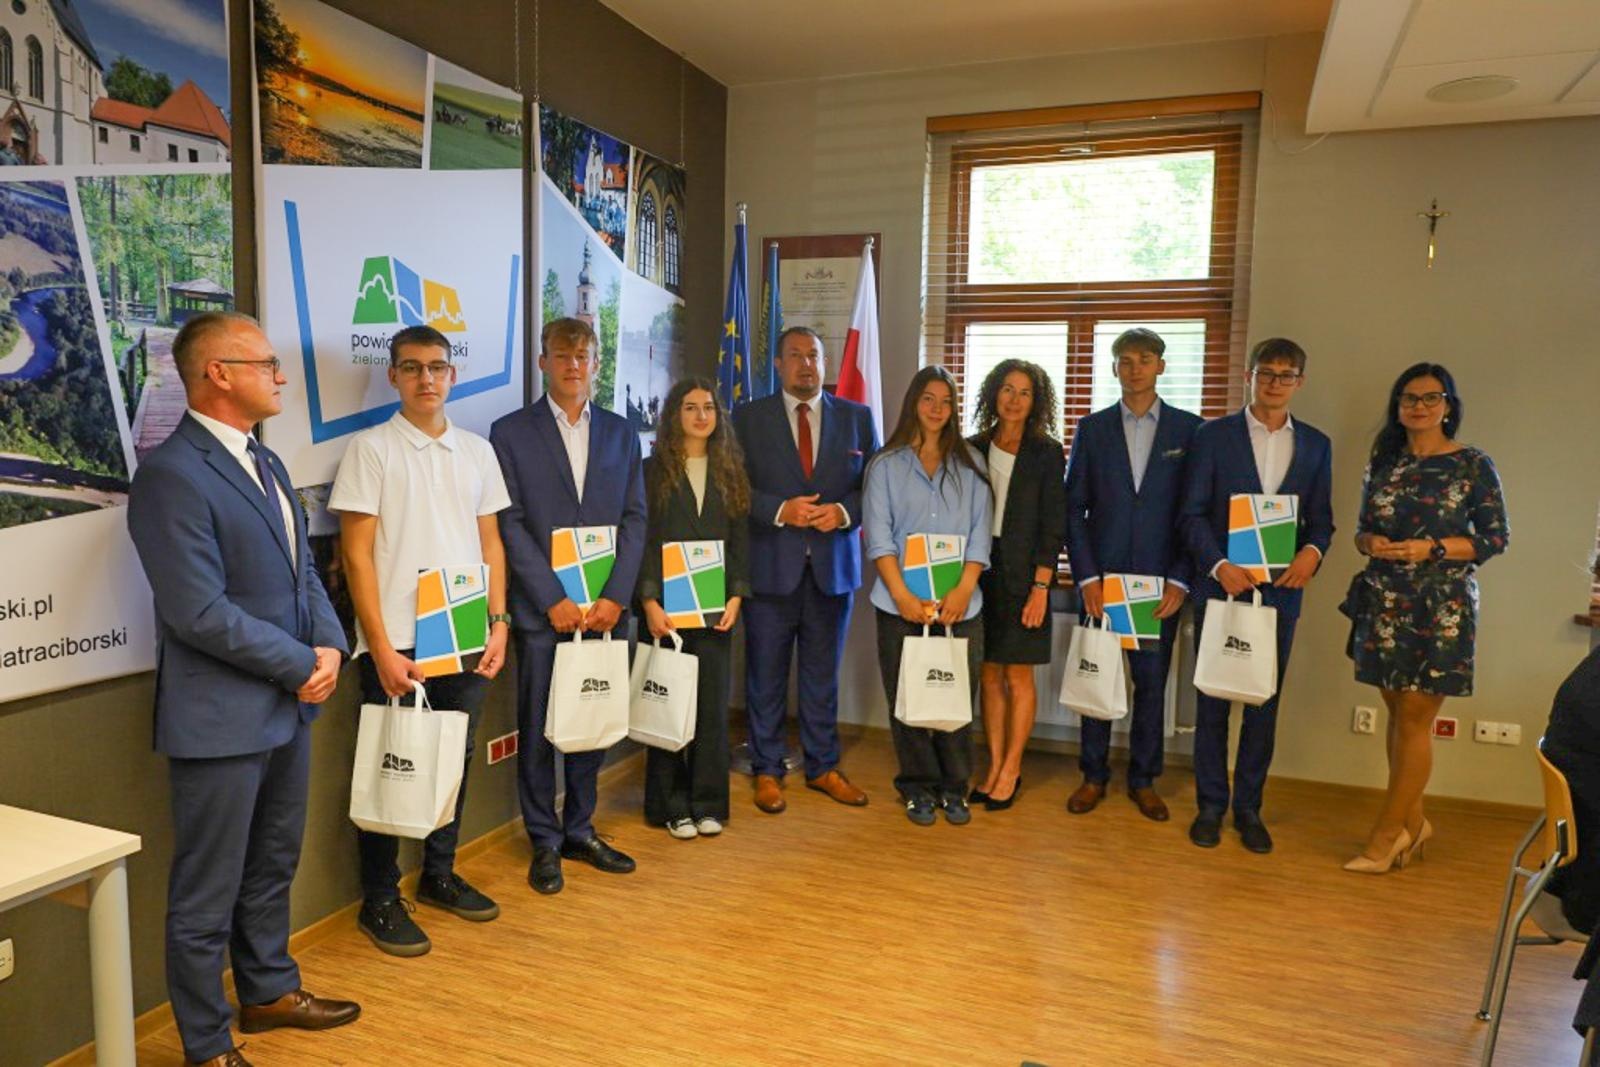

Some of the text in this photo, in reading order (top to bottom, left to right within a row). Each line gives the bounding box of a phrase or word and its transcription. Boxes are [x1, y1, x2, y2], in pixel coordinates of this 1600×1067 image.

[351, 354, 390, 366] zielon
[0, 594, 52, 620] ski.pl
[0, 627, 127, 668] atraciborski
